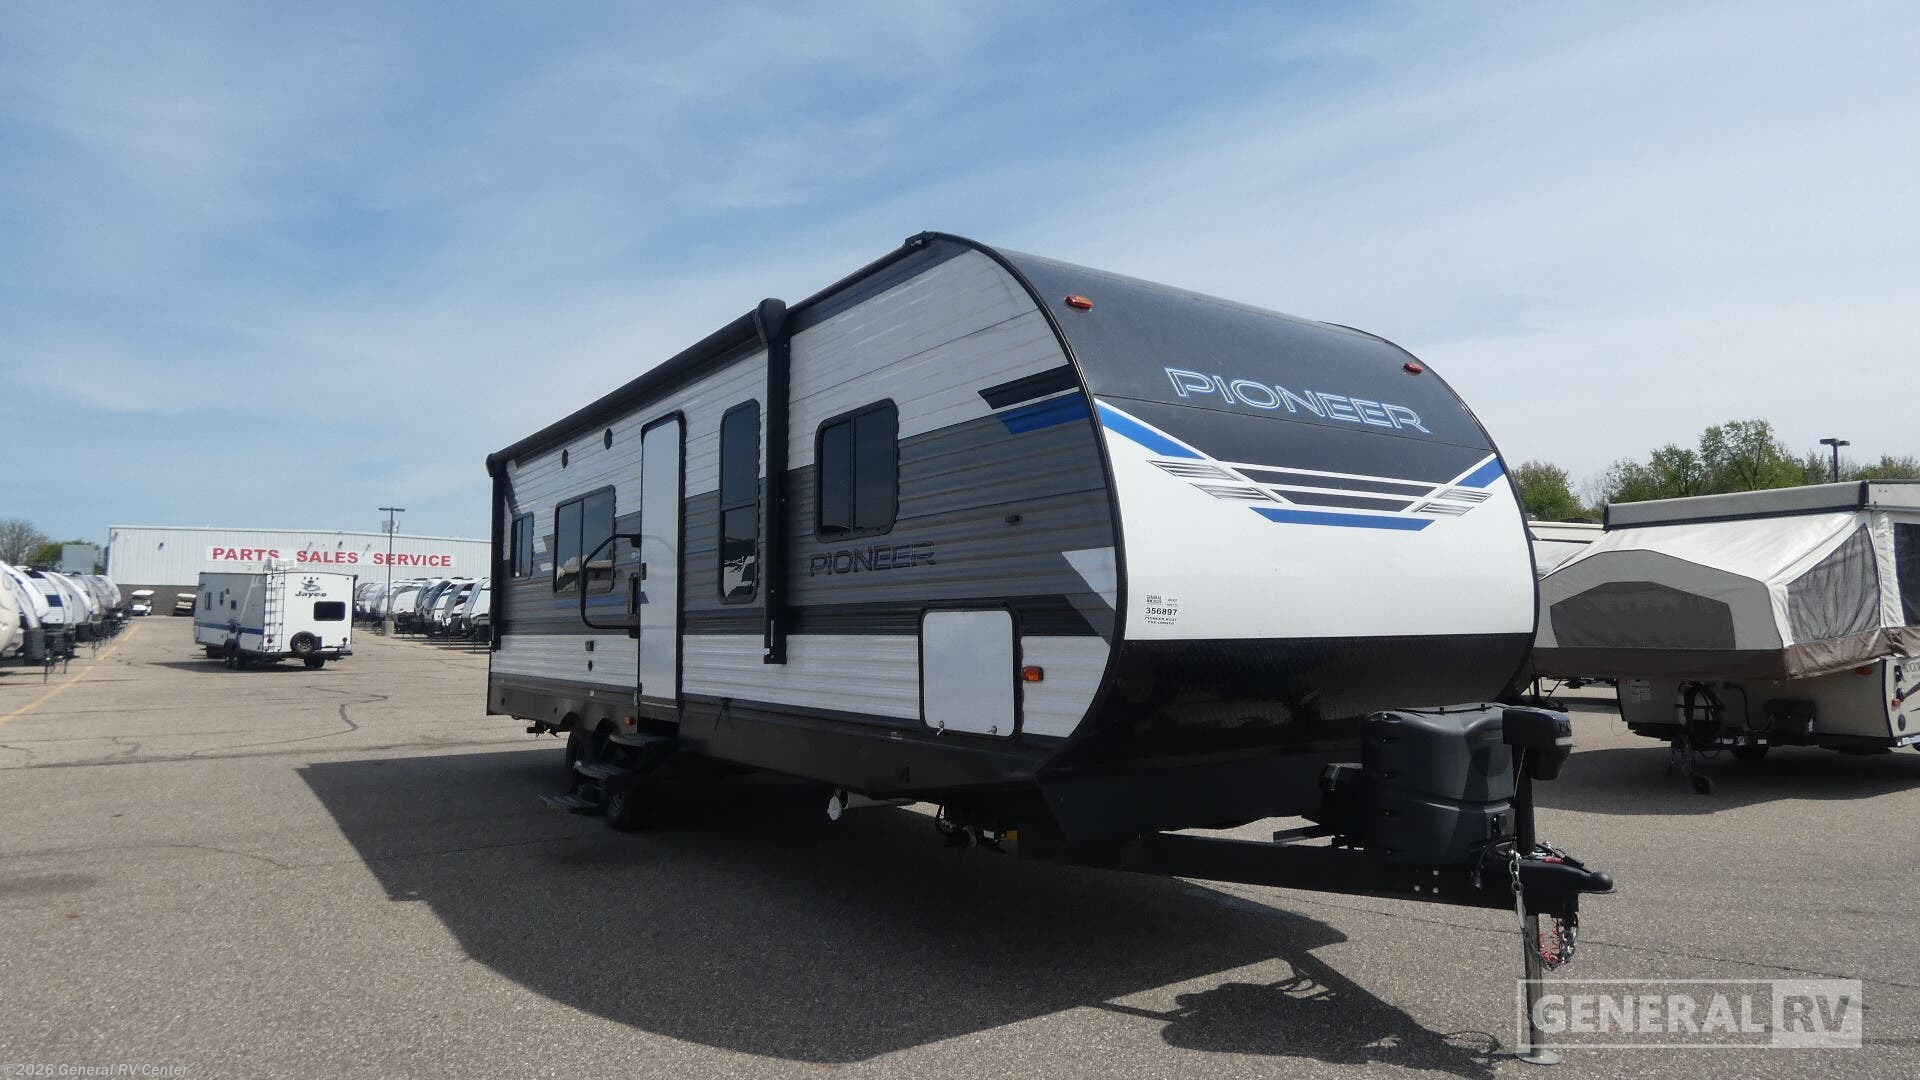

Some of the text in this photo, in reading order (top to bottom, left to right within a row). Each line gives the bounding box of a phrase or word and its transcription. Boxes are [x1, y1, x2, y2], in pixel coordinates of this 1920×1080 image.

[1163, 366, 1432, 435] PIONEER
[212, 547, 452, 567] PARTS SALES SERVICE
[809, 540, 937, 577] PIONEER
[295, 590, 327, 598] Jayco
[1145, 607, 1178, 616] 356897
